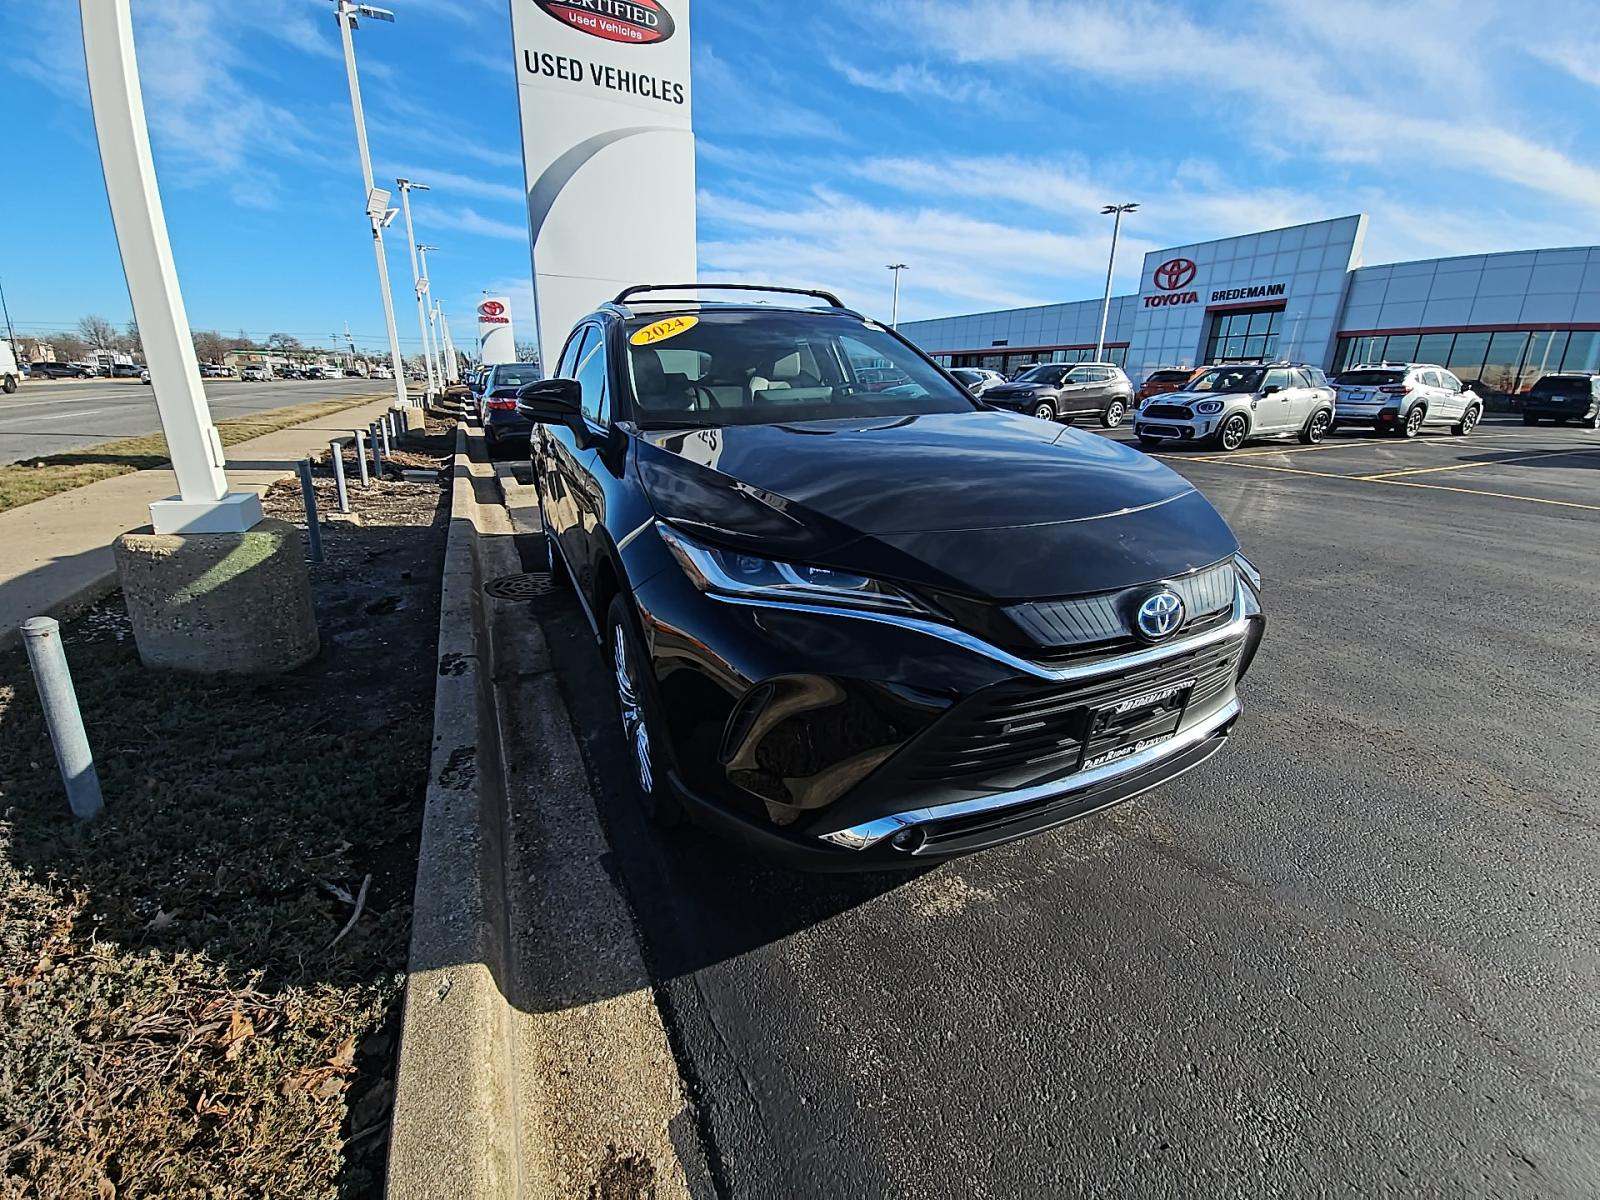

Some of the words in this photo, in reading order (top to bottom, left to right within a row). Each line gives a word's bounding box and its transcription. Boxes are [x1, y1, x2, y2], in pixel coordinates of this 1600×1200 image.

[556, 0, 659, 27] RTIFIED
[568, 11, 597, 28] Used
[599, 19, 643, 40] Vehicles
[524, 49, 584, 83] USED
[590, 63, 685, 105] VEHICLES
[1143, 291, 1199, 308] TOYOTA
[1211, 283, 1286, 302] BREDEMANN
[641, 319, 685, 341] 2024
